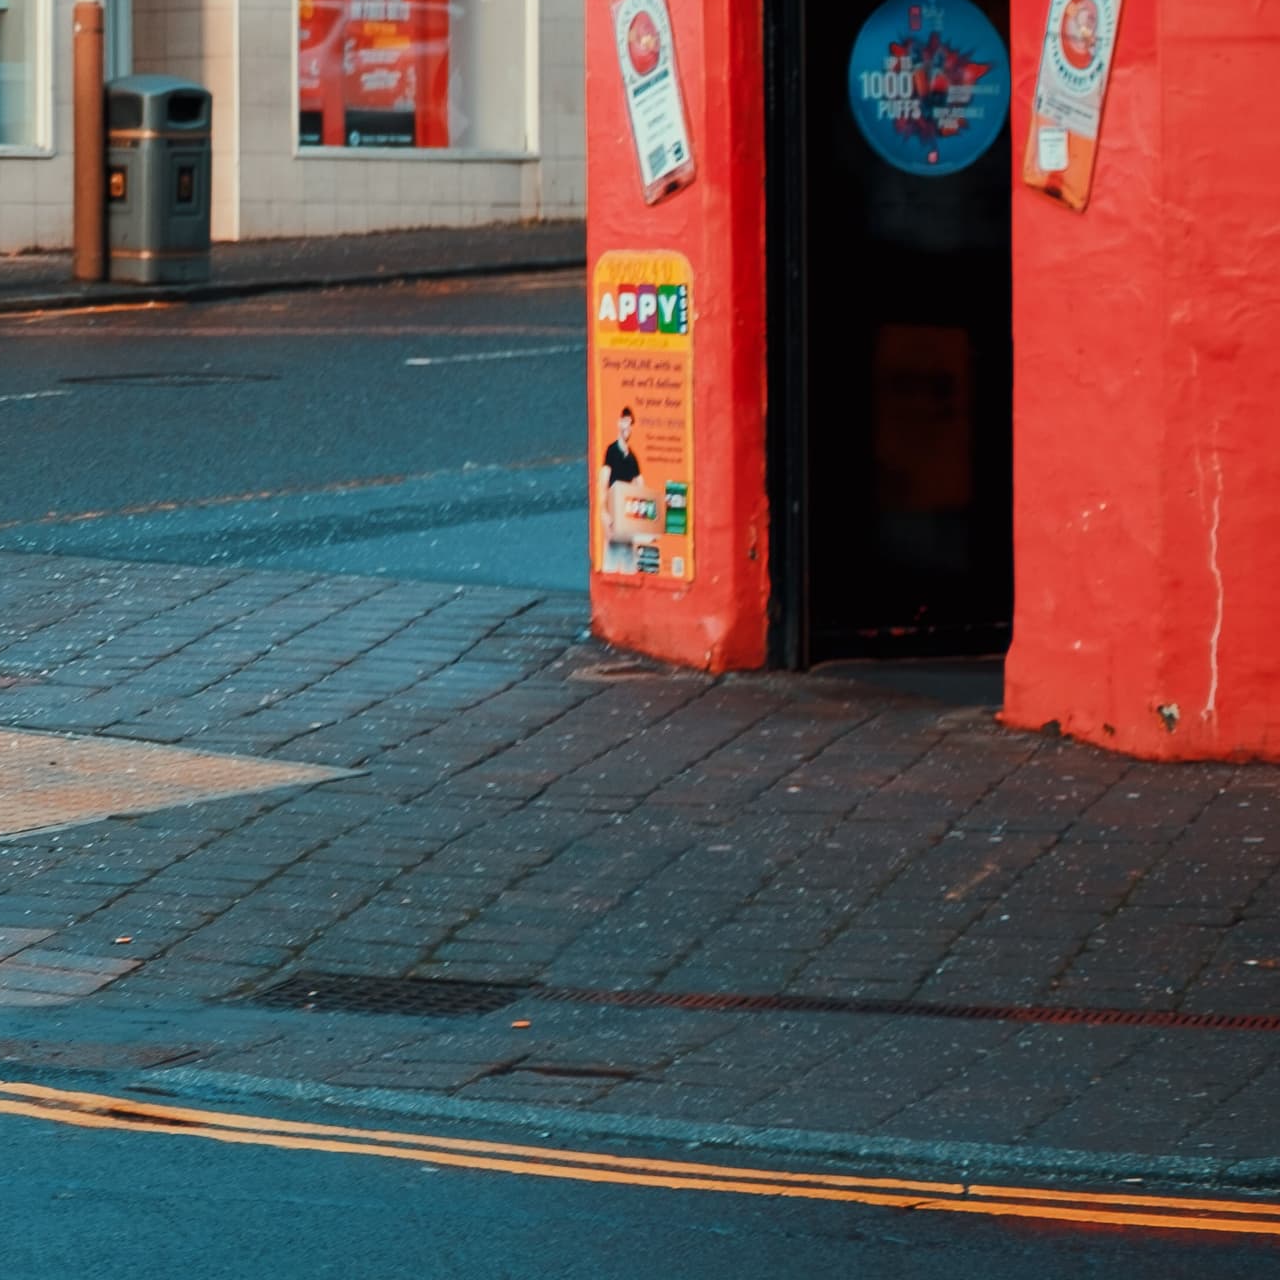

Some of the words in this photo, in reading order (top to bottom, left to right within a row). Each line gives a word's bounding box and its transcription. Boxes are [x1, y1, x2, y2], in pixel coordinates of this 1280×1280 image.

[860, 71, 913, 100] 1000
[878, 99, 922, 120] PUFFS
[598, 291, 678, 325] APPY
